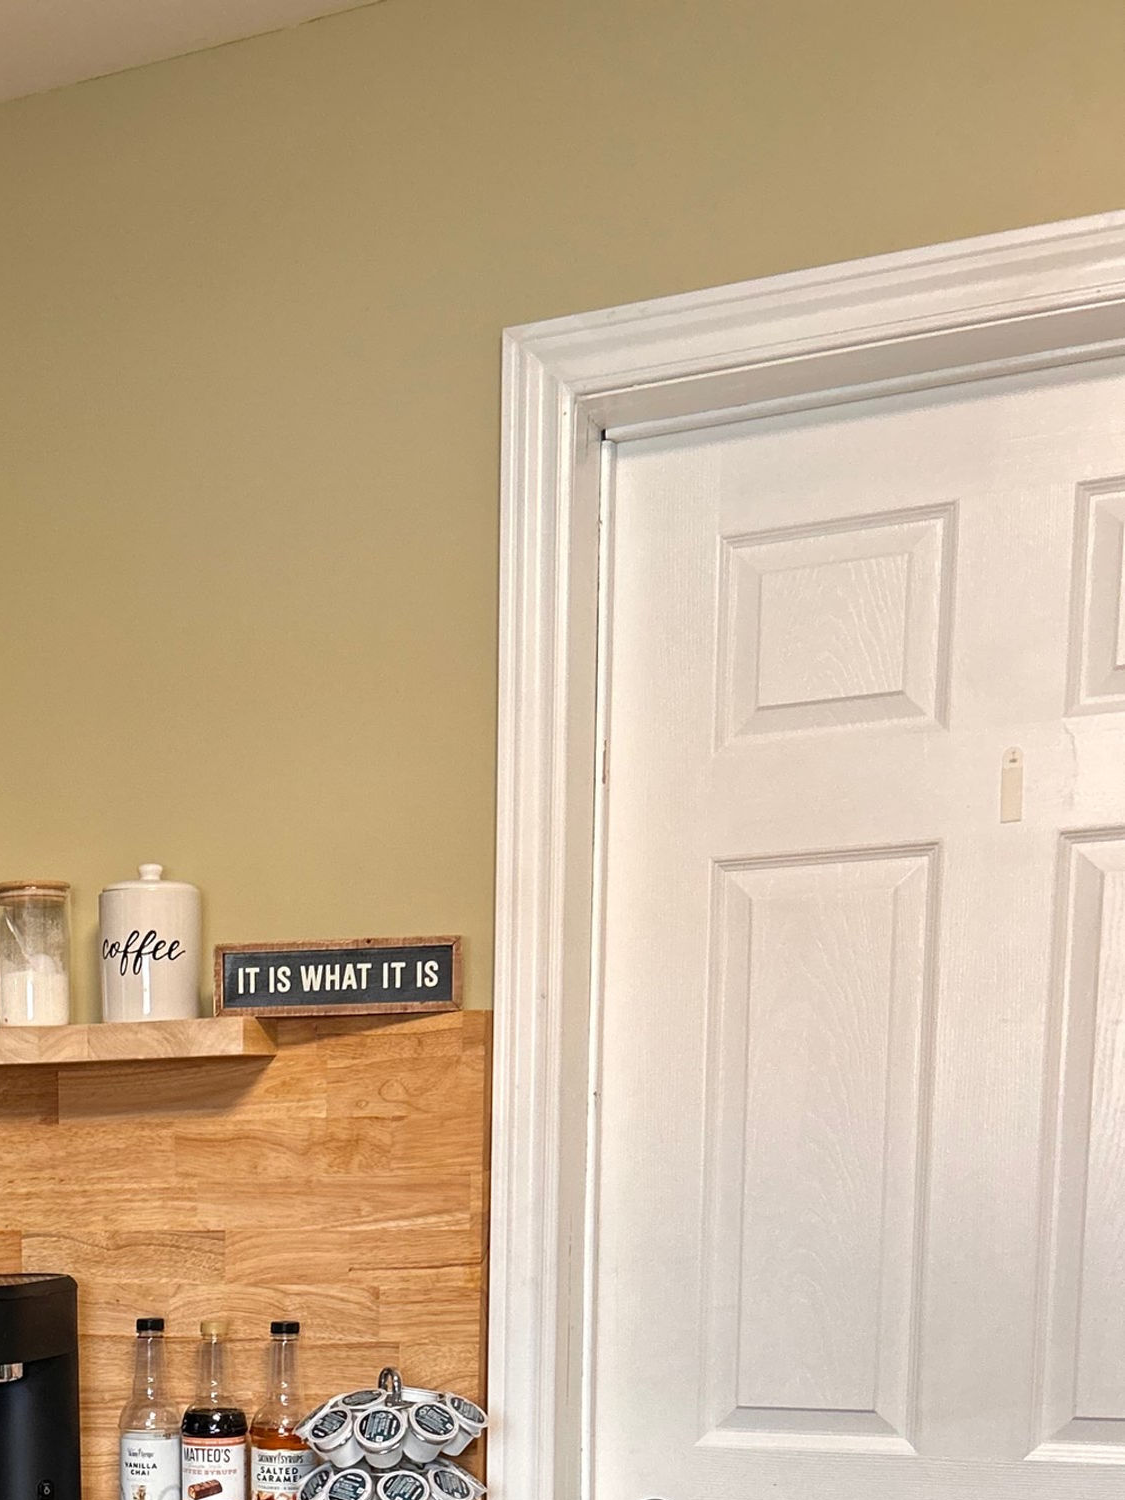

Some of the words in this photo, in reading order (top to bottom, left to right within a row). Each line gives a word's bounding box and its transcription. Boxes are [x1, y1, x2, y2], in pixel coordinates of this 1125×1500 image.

[102, 929, 186, 977] coffee
[238, 967, 260, 995] IT
[268, 966, 292, 994] IS
[300, 963, 372, 992] WHAT
[382, 961, 406, 989] IT
[416, 960, 439, 988] IS
[124, 1461, 158, 1470] VANILLA
[260, 1465, 299, 1475] SALTED
